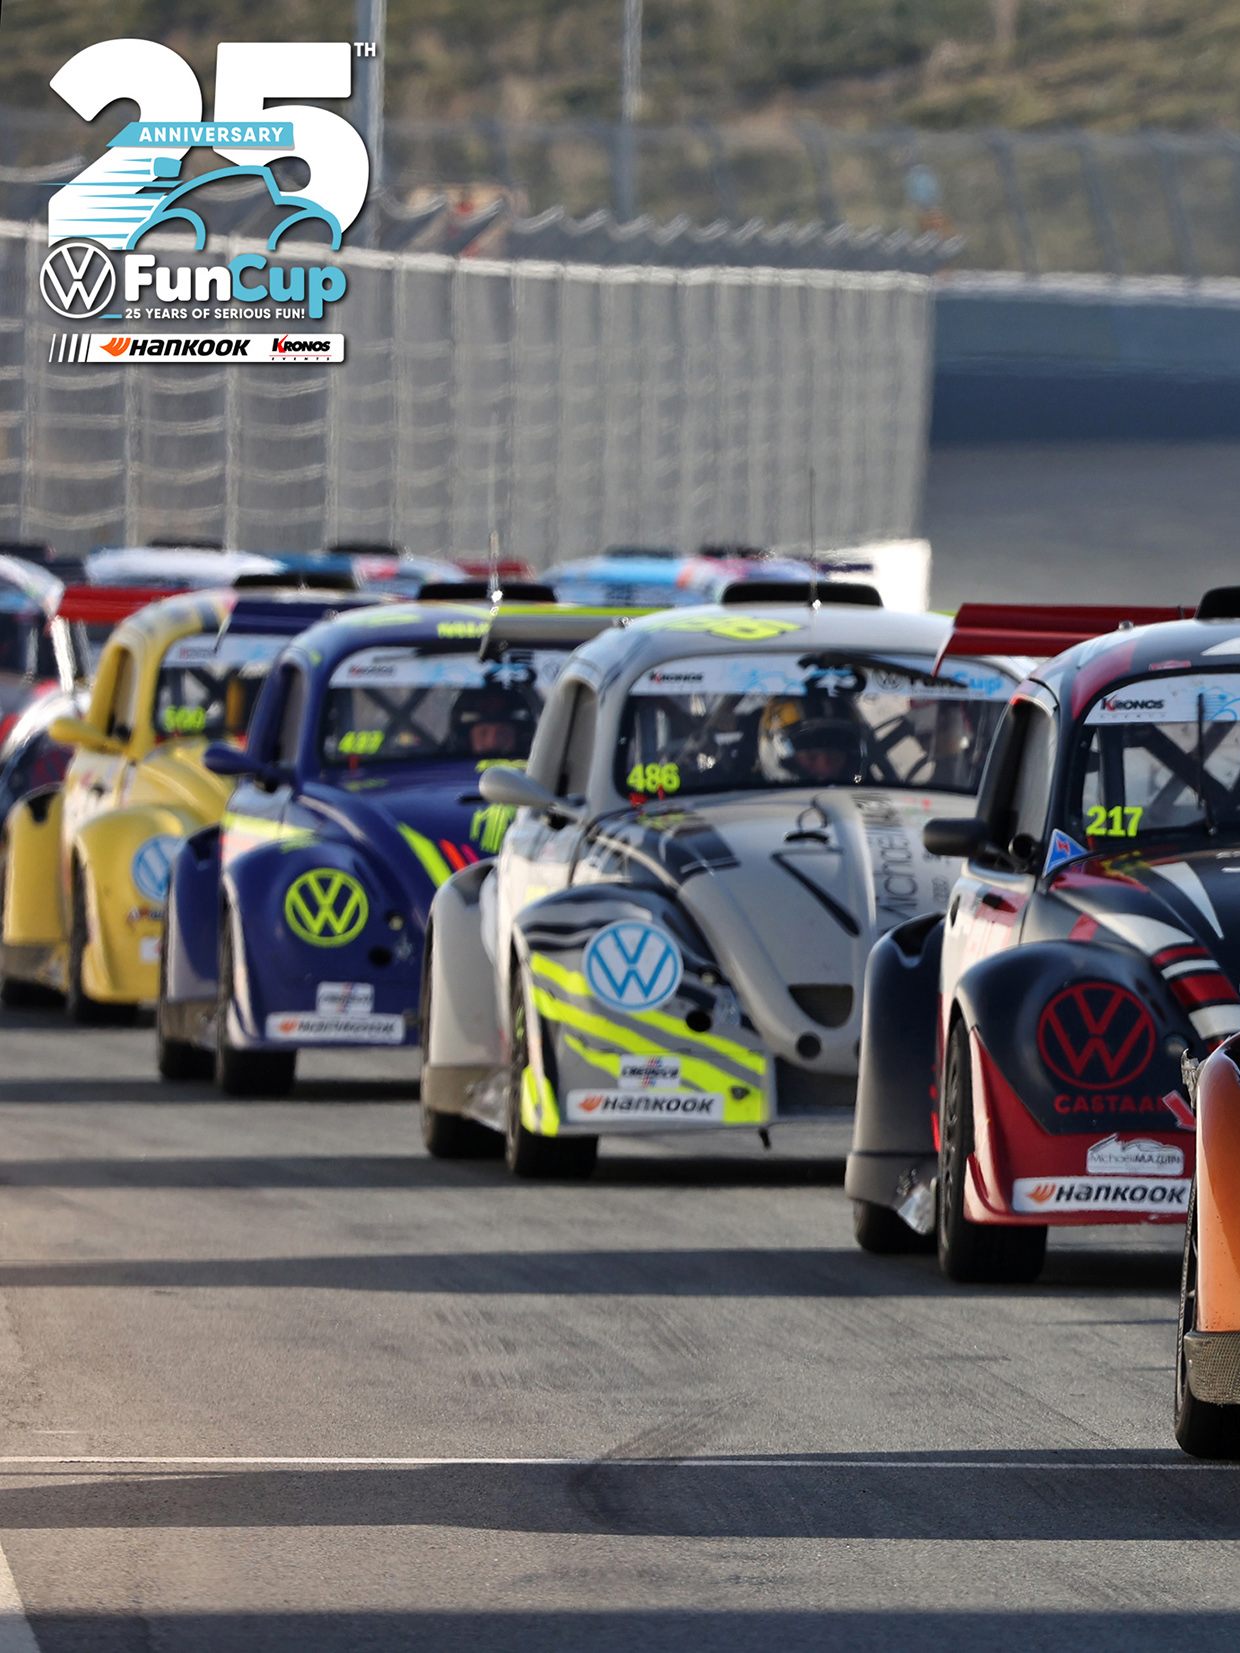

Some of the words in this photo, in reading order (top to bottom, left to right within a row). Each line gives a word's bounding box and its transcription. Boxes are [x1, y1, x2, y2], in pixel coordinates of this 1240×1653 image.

[1101, 694, 1165, 711] KRONOS
[626, 762, 681, 793] 486
[1086, 806, 1143, 837] 217
